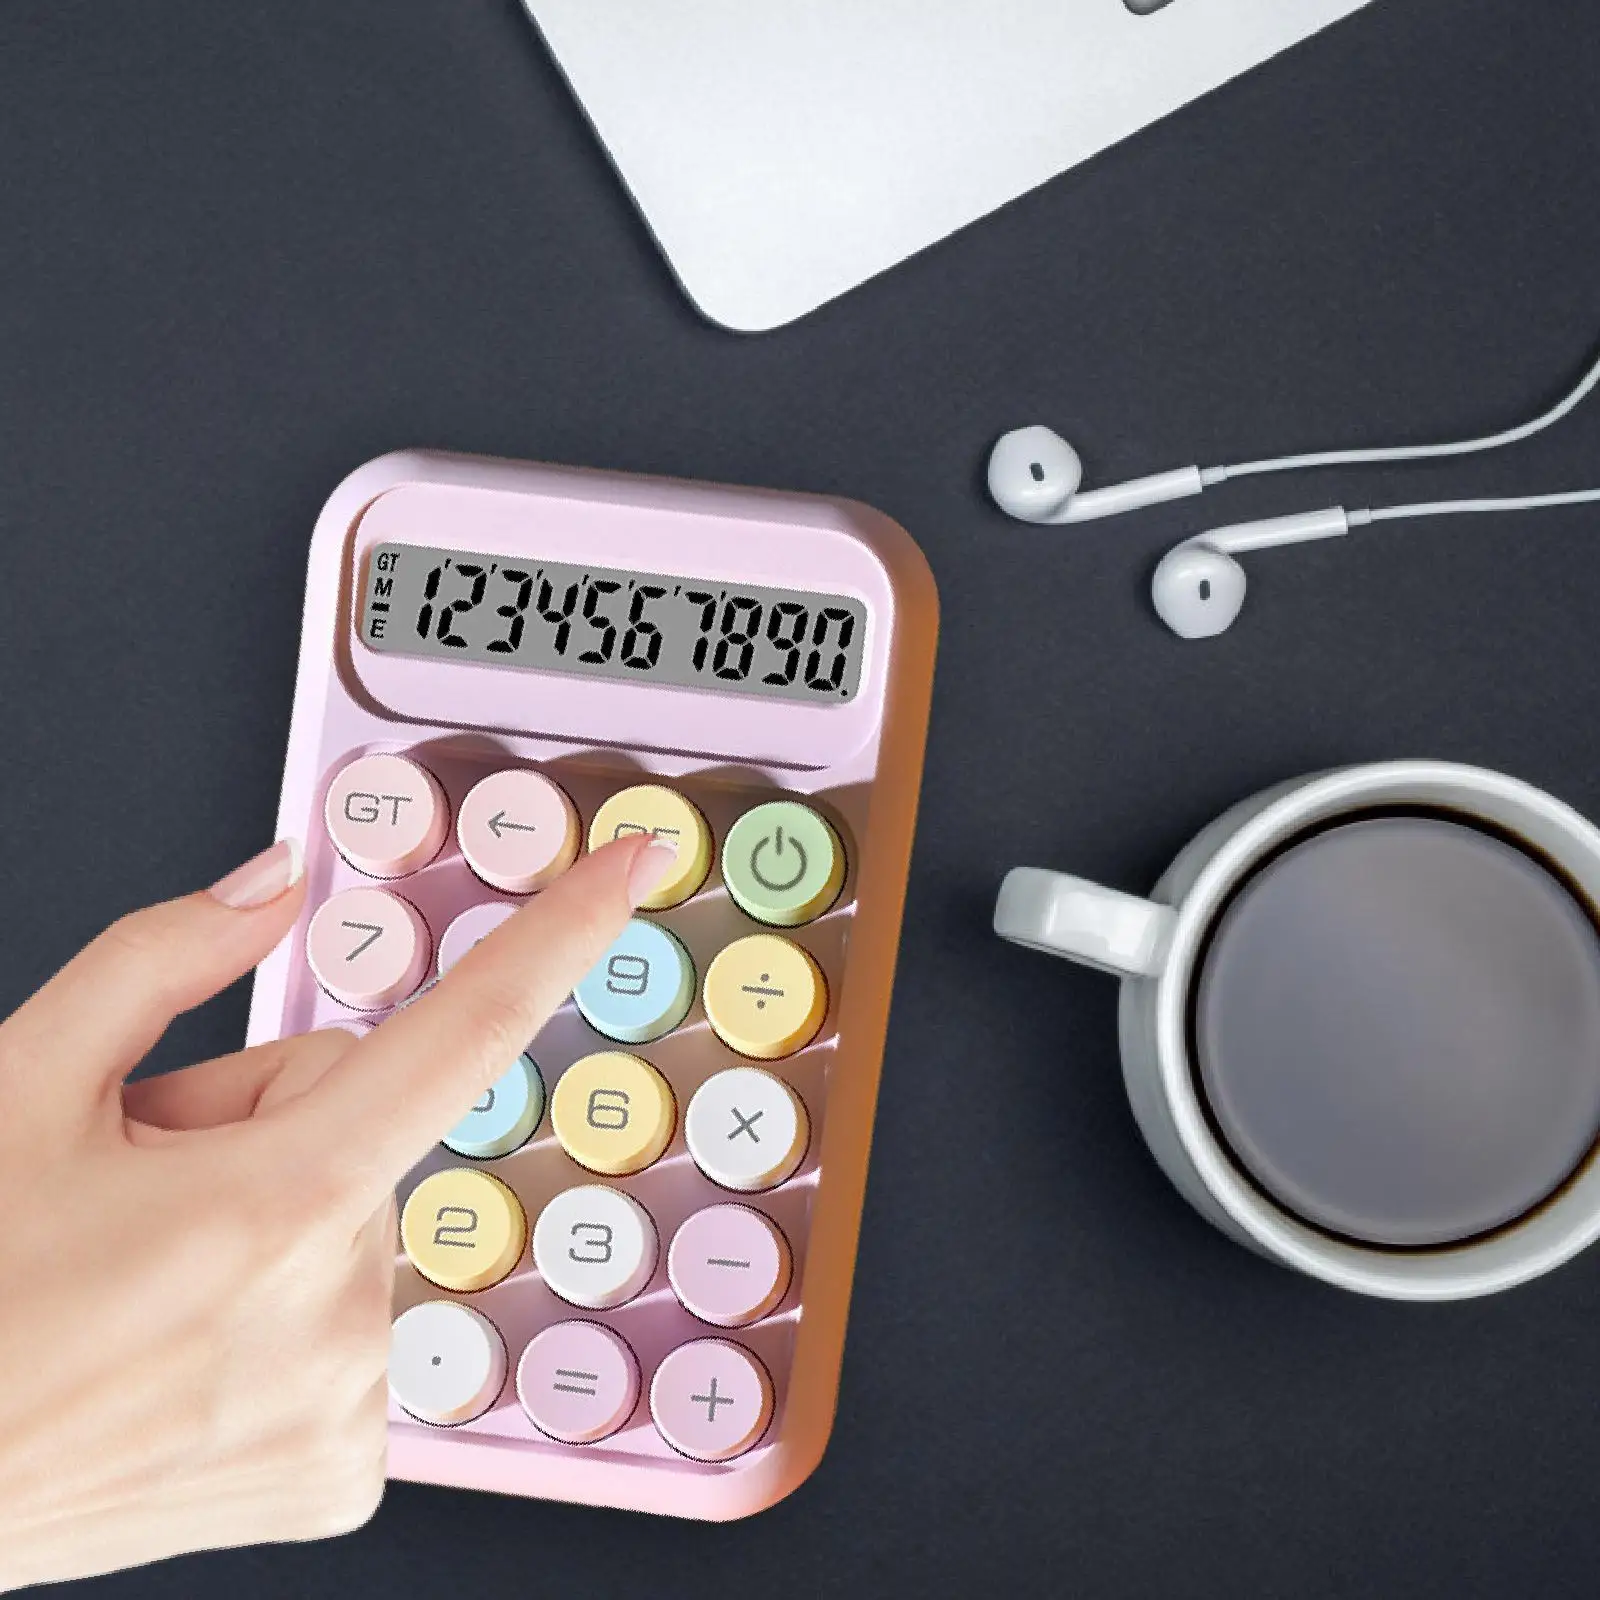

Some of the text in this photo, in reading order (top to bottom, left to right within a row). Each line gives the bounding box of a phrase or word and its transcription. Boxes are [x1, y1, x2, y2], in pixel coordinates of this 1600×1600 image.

[377, 552, 401, 572] GT
[374, 576, 394, 598] M
[369, 617, 387, 639] E
[344, 791, 412, 826] GT
[341, 920, 384, 962] 7
[606, 954, 650, 996] 9
[587, 1089, 630, 1130] 6
[433, 1206, 478, 1249] 2
[569, 1222, 613, 1264] 3
